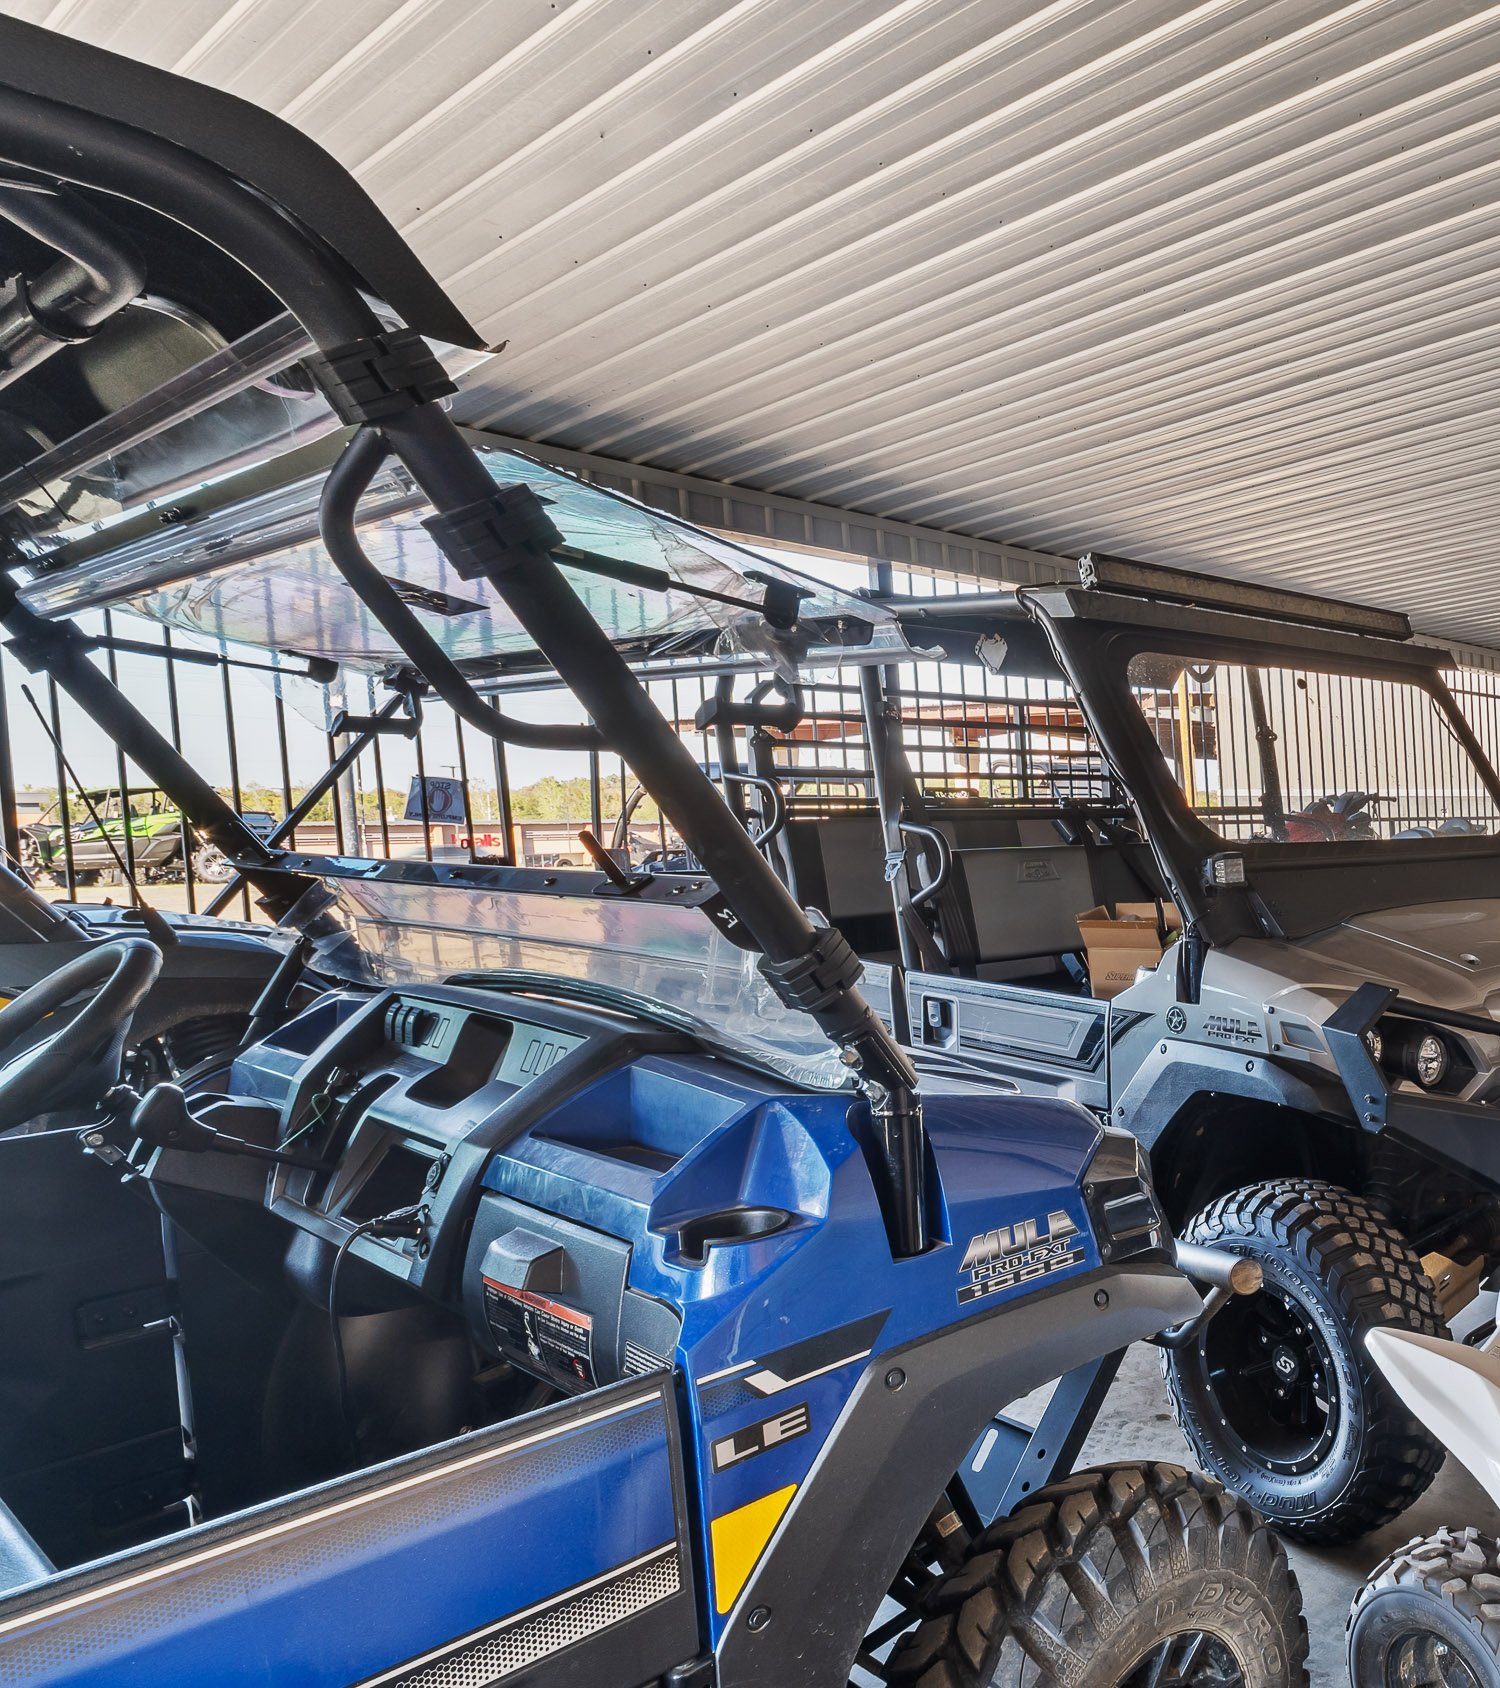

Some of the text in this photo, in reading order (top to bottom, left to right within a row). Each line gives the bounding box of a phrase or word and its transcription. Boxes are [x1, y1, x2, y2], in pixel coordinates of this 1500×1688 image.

[1203, 1015, 1263, 1038] MULE
[957, 1208, 1082, 1275] MULE
[971, 1238, 1072, 1282] PRO-FXT
[970, 1253, 1076, 1298] 1000
[714, 1406, 809, 1469] LE
[1192, 1581, 1283, 1677] DURO
